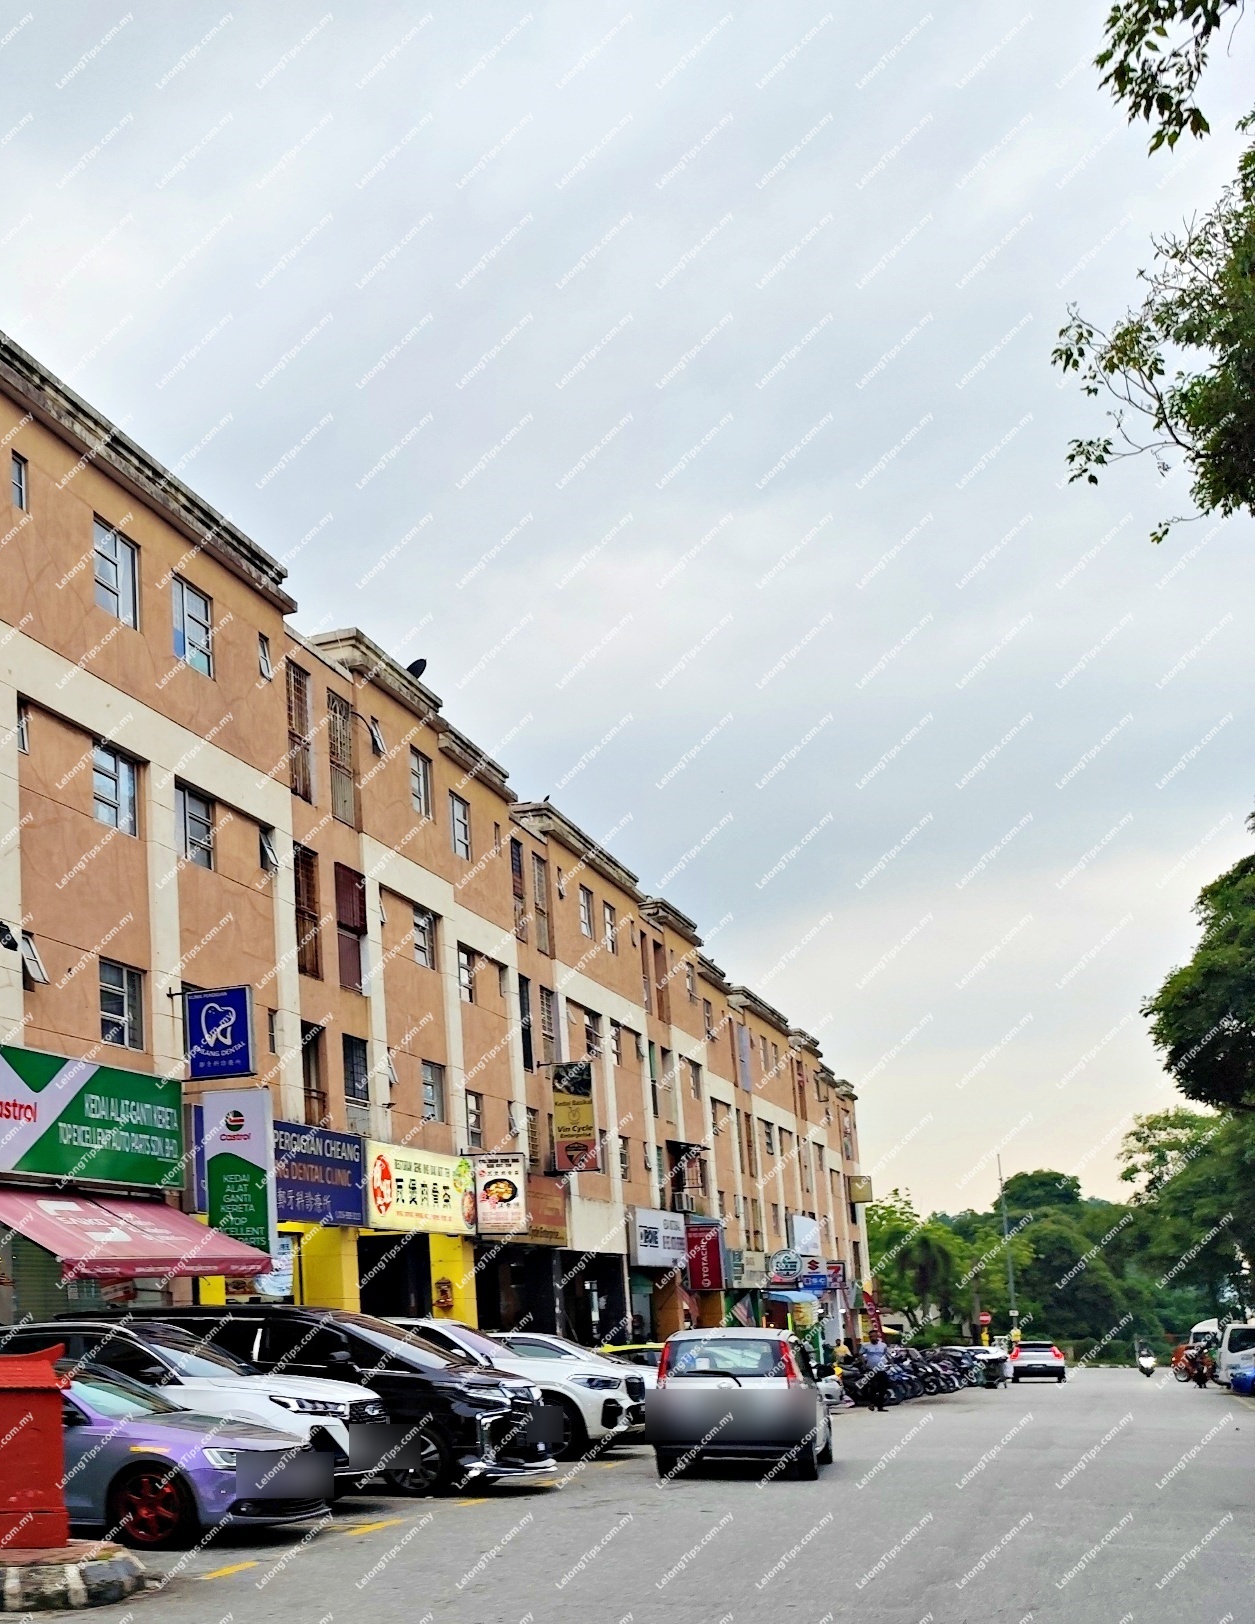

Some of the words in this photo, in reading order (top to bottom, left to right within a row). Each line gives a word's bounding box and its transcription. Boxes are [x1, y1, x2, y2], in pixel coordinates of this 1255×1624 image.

[572, 1125, 593, 1133] Cycle
[219, 1133, 251, 1141] Castrol
[324, 1139, 360, 1162] CHEANG
[223, 1174, 250, 1183] KEDAI
[290, 1162, 325, 1183] DENTAL
[325, 1167, 352, 1187] CLINIC
[225, 1184, 248, 1192] ALAT
[222, 1193, 252, 1203] GANTI
[220, 1203, 256, 1213] KERETA
[229, 1217, 247, 1226] TOP
